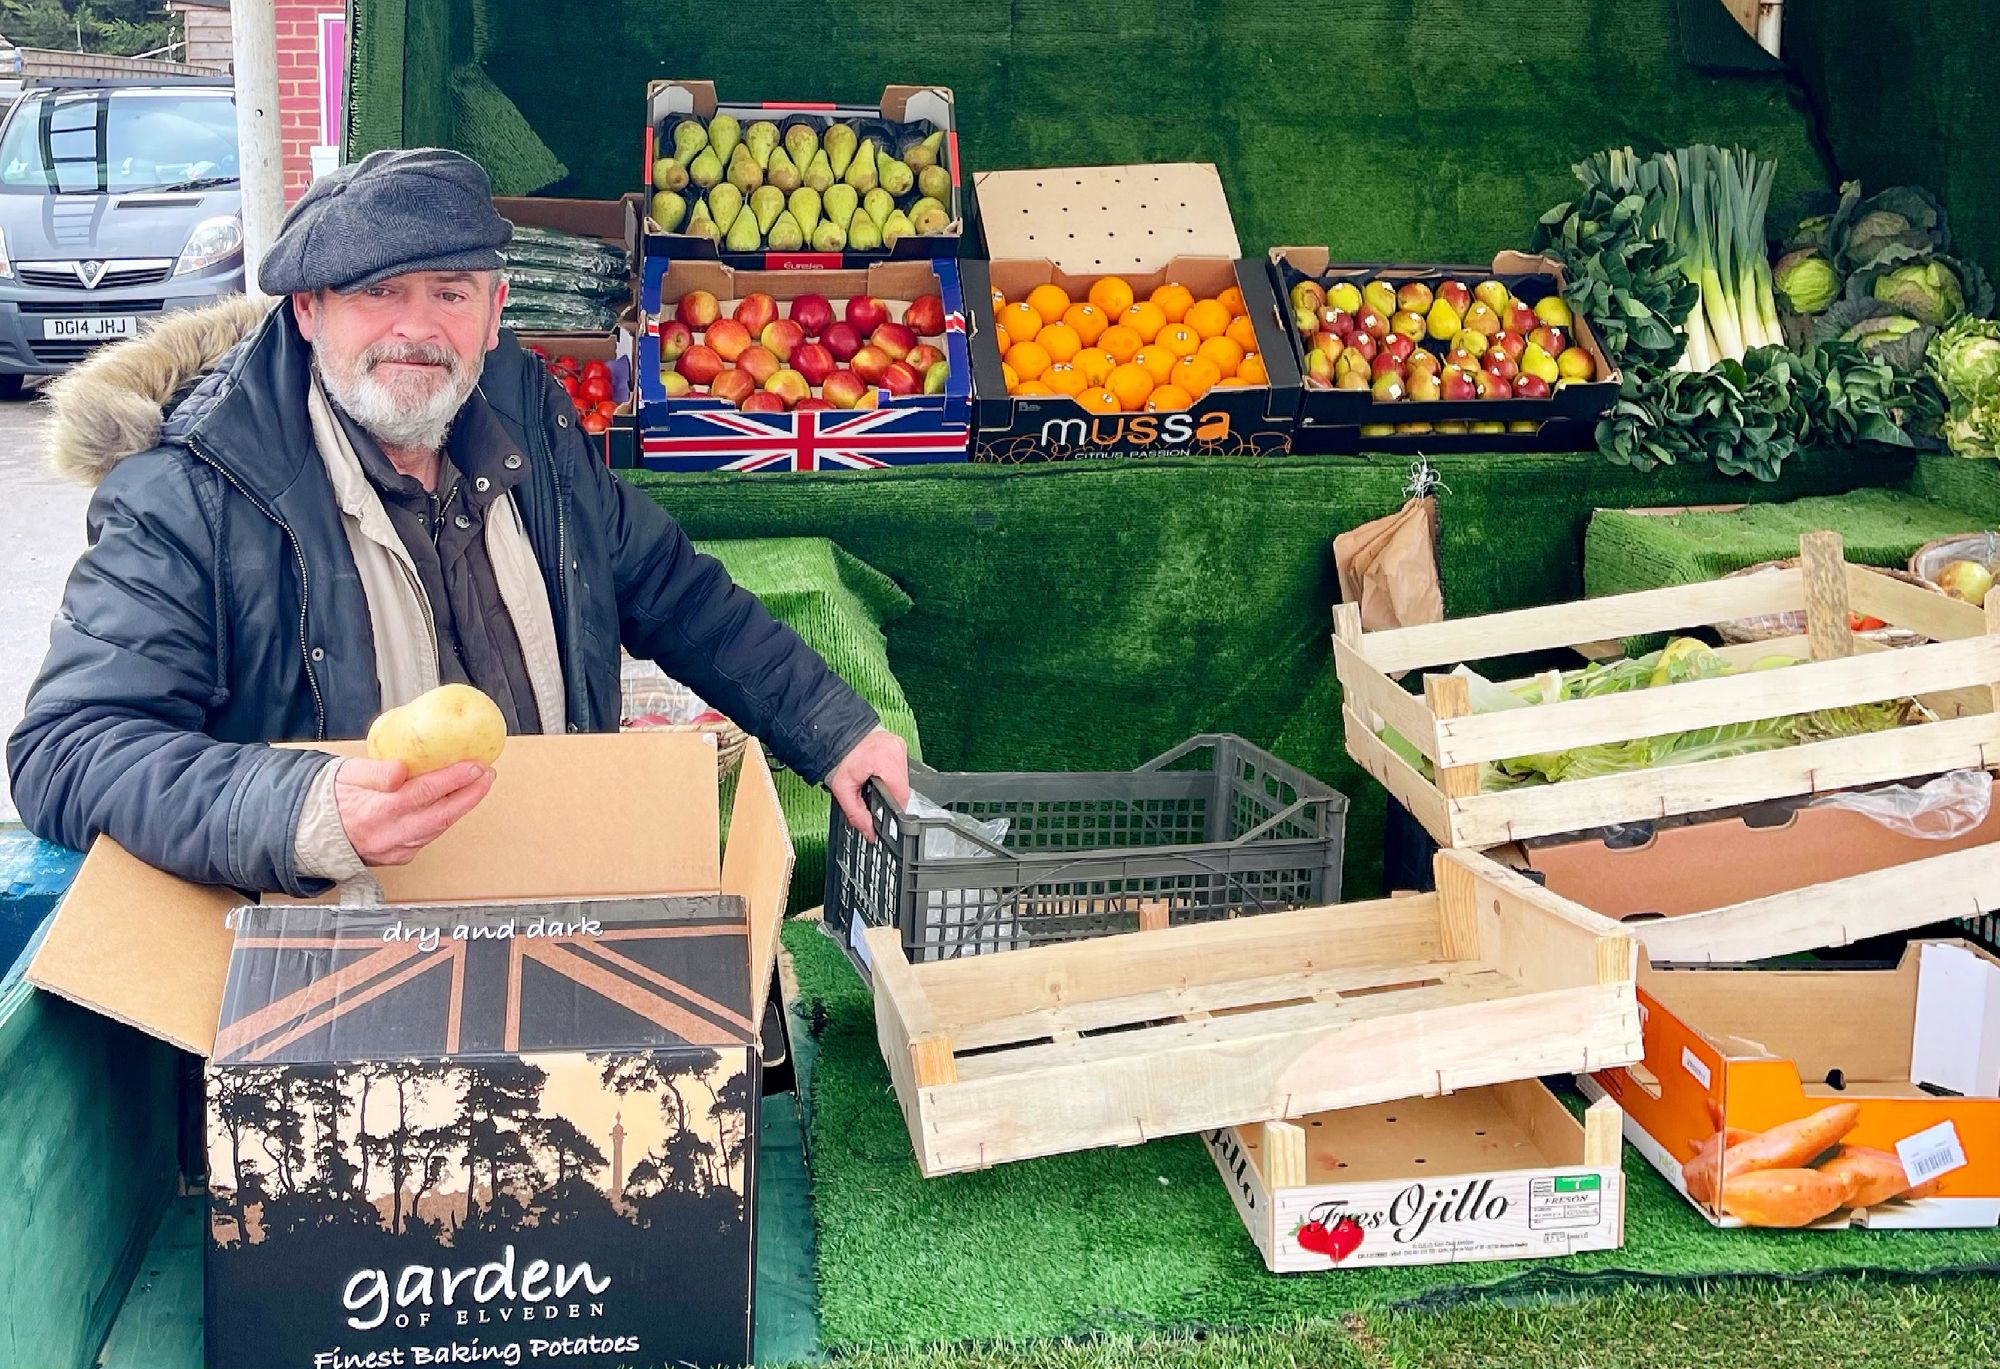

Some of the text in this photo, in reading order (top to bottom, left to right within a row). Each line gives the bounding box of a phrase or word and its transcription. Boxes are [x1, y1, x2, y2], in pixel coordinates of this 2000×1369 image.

[54, 319, 126, 335] DG14 JHJ
[1041, 411, 1230, 446] mussa
[1074, 448, 1191, 460] CITRUS PASSION
[382, 916, 604, 952] dry and dark
[1308, 1179, 1518, 1244] Tres Ojillo
[343, 1244, 612, 1330] garden
[395, 1303, 604, 1328] OF ELVEDEN
[313, 1335, 641, 1369] Finest Baking Potatoes
